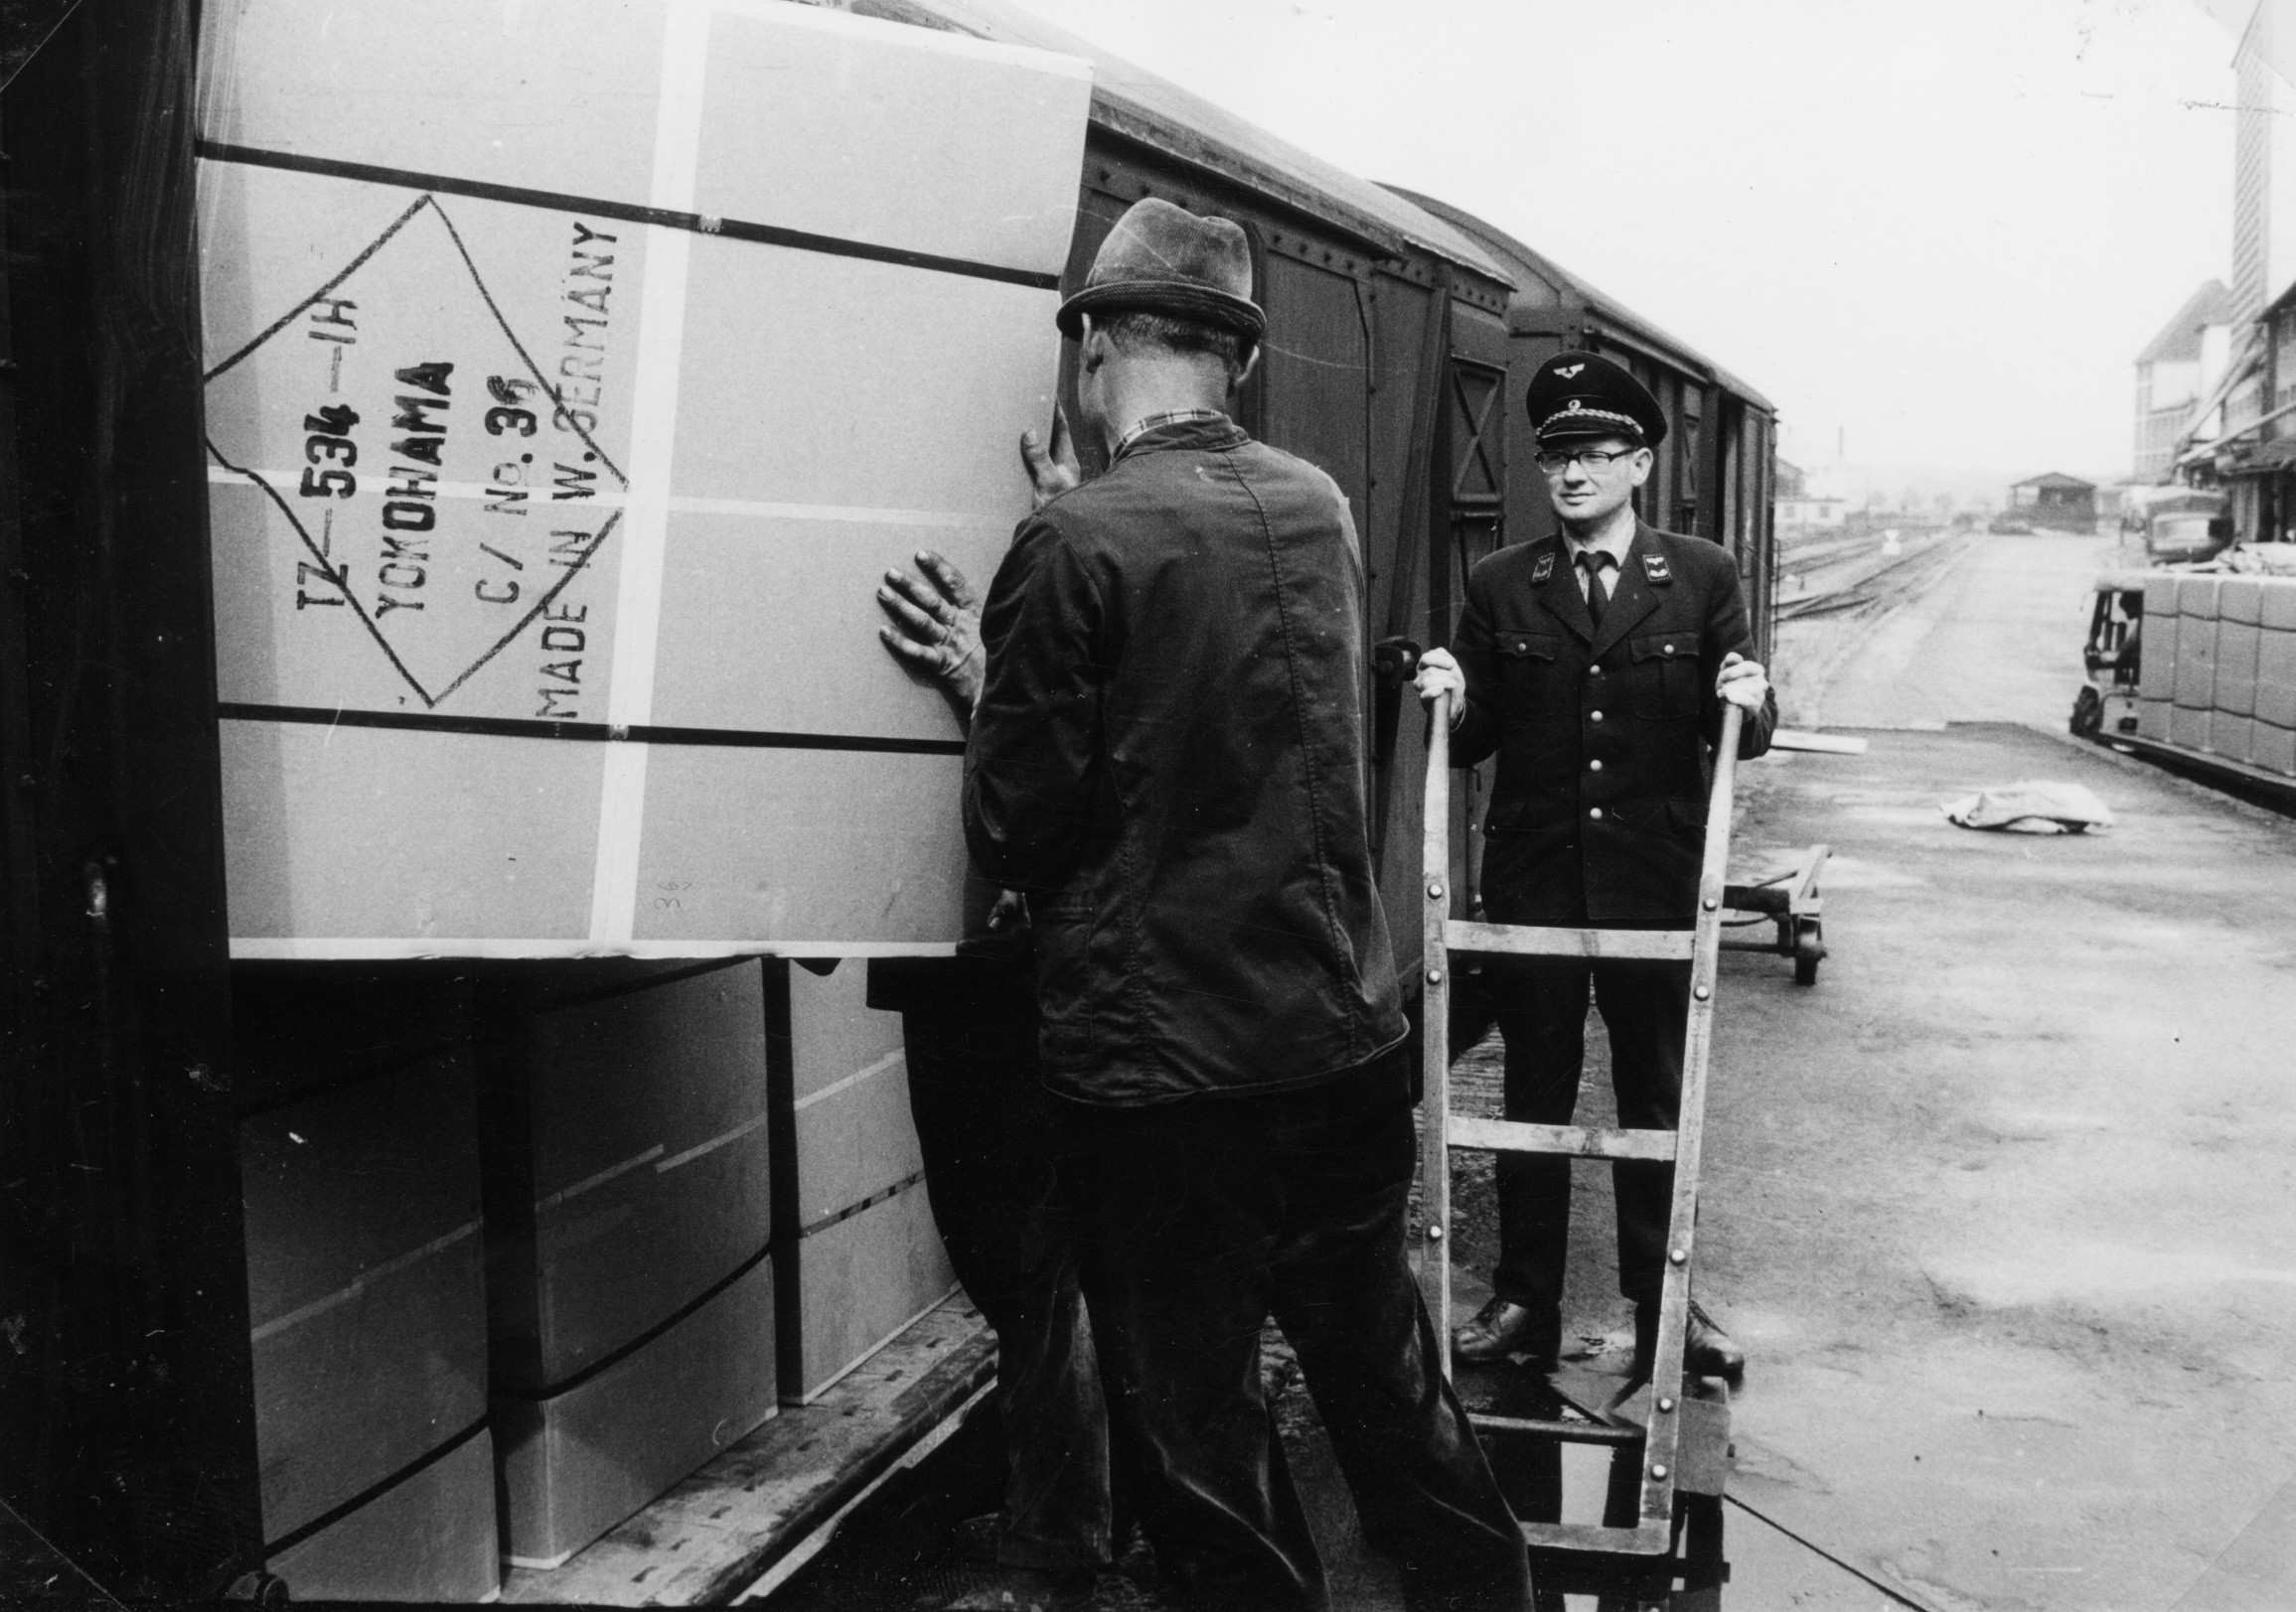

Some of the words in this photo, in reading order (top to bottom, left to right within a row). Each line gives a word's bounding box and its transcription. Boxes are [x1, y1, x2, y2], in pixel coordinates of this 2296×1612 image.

[375, 363, 454, 620] YOKOHAMA
[551, 450, 597, 501] W.
[547, 530, 593, 569] IN
[536, 603, 588, 719] MADE
